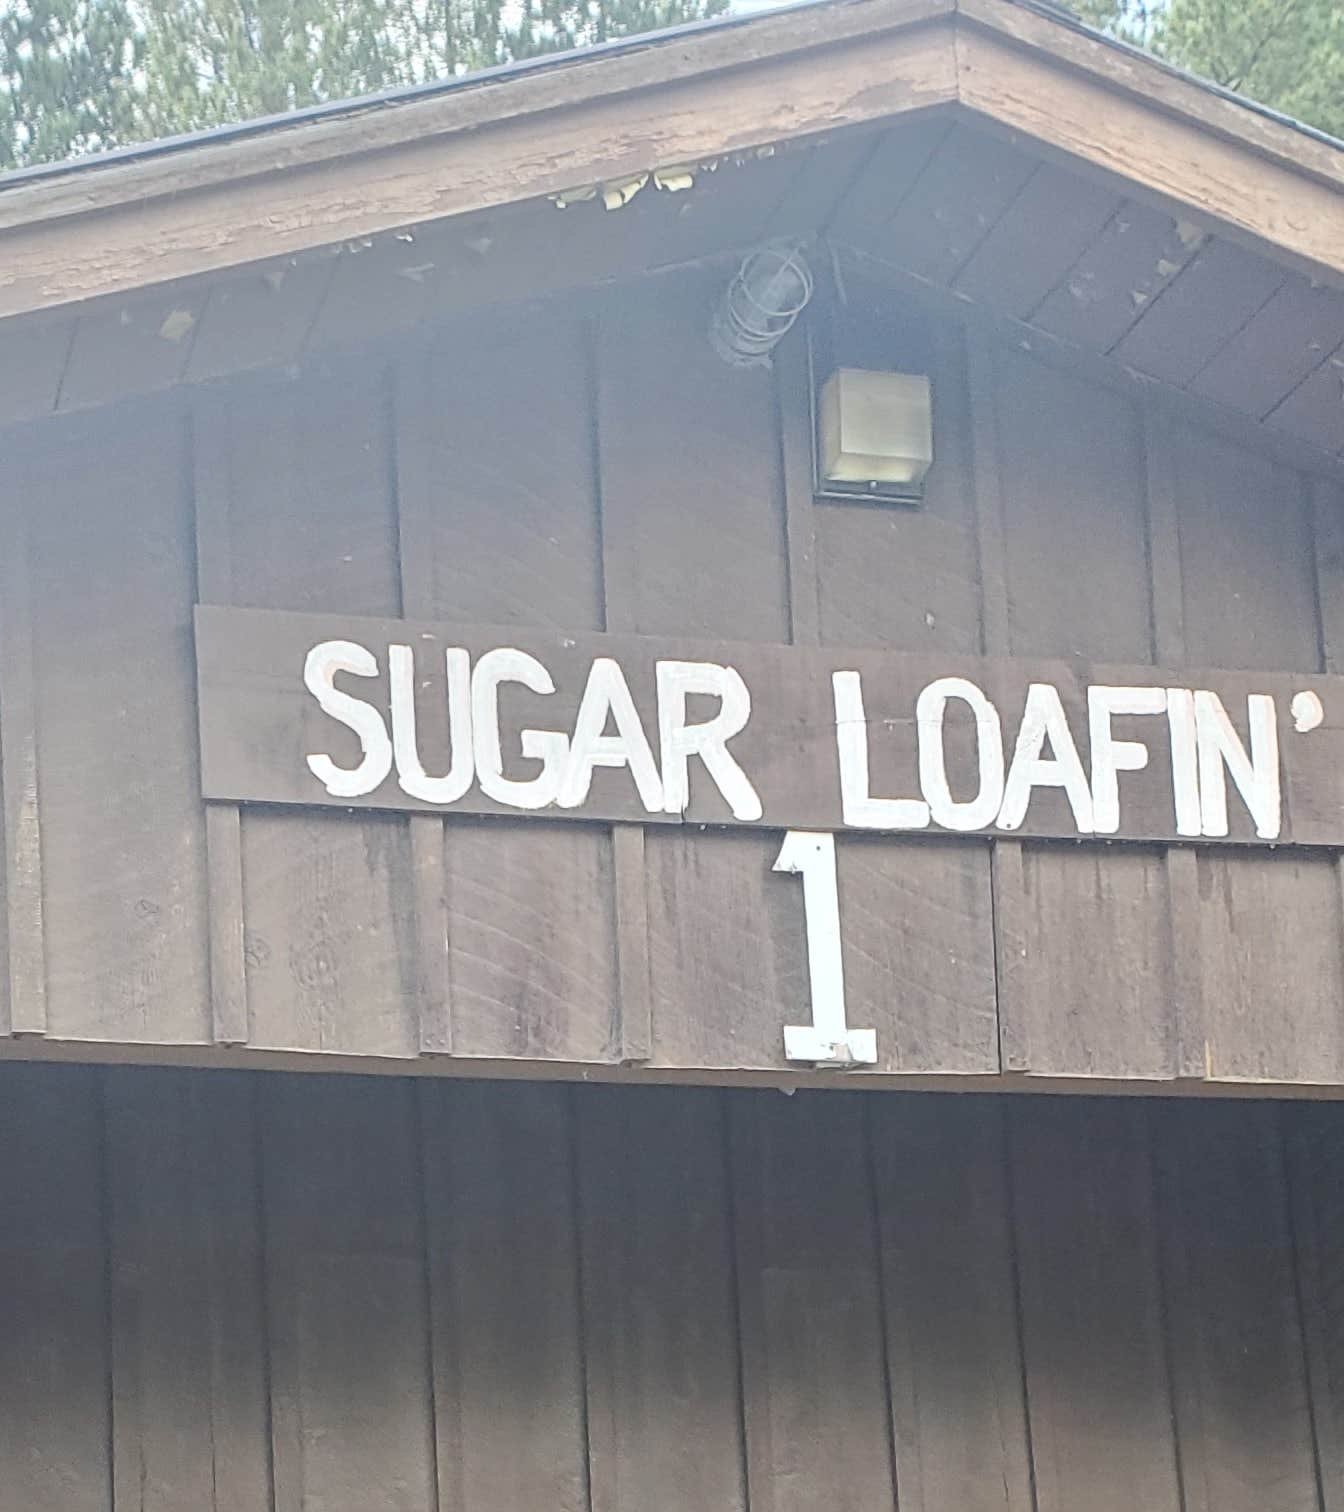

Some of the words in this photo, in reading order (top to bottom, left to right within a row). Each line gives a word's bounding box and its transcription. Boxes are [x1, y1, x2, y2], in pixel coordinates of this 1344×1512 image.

[302, 639, 764, 822] SUGAR
[831, 669, 1325, 841] LOAFIN'
[771, 829, 878, 1066] 1
